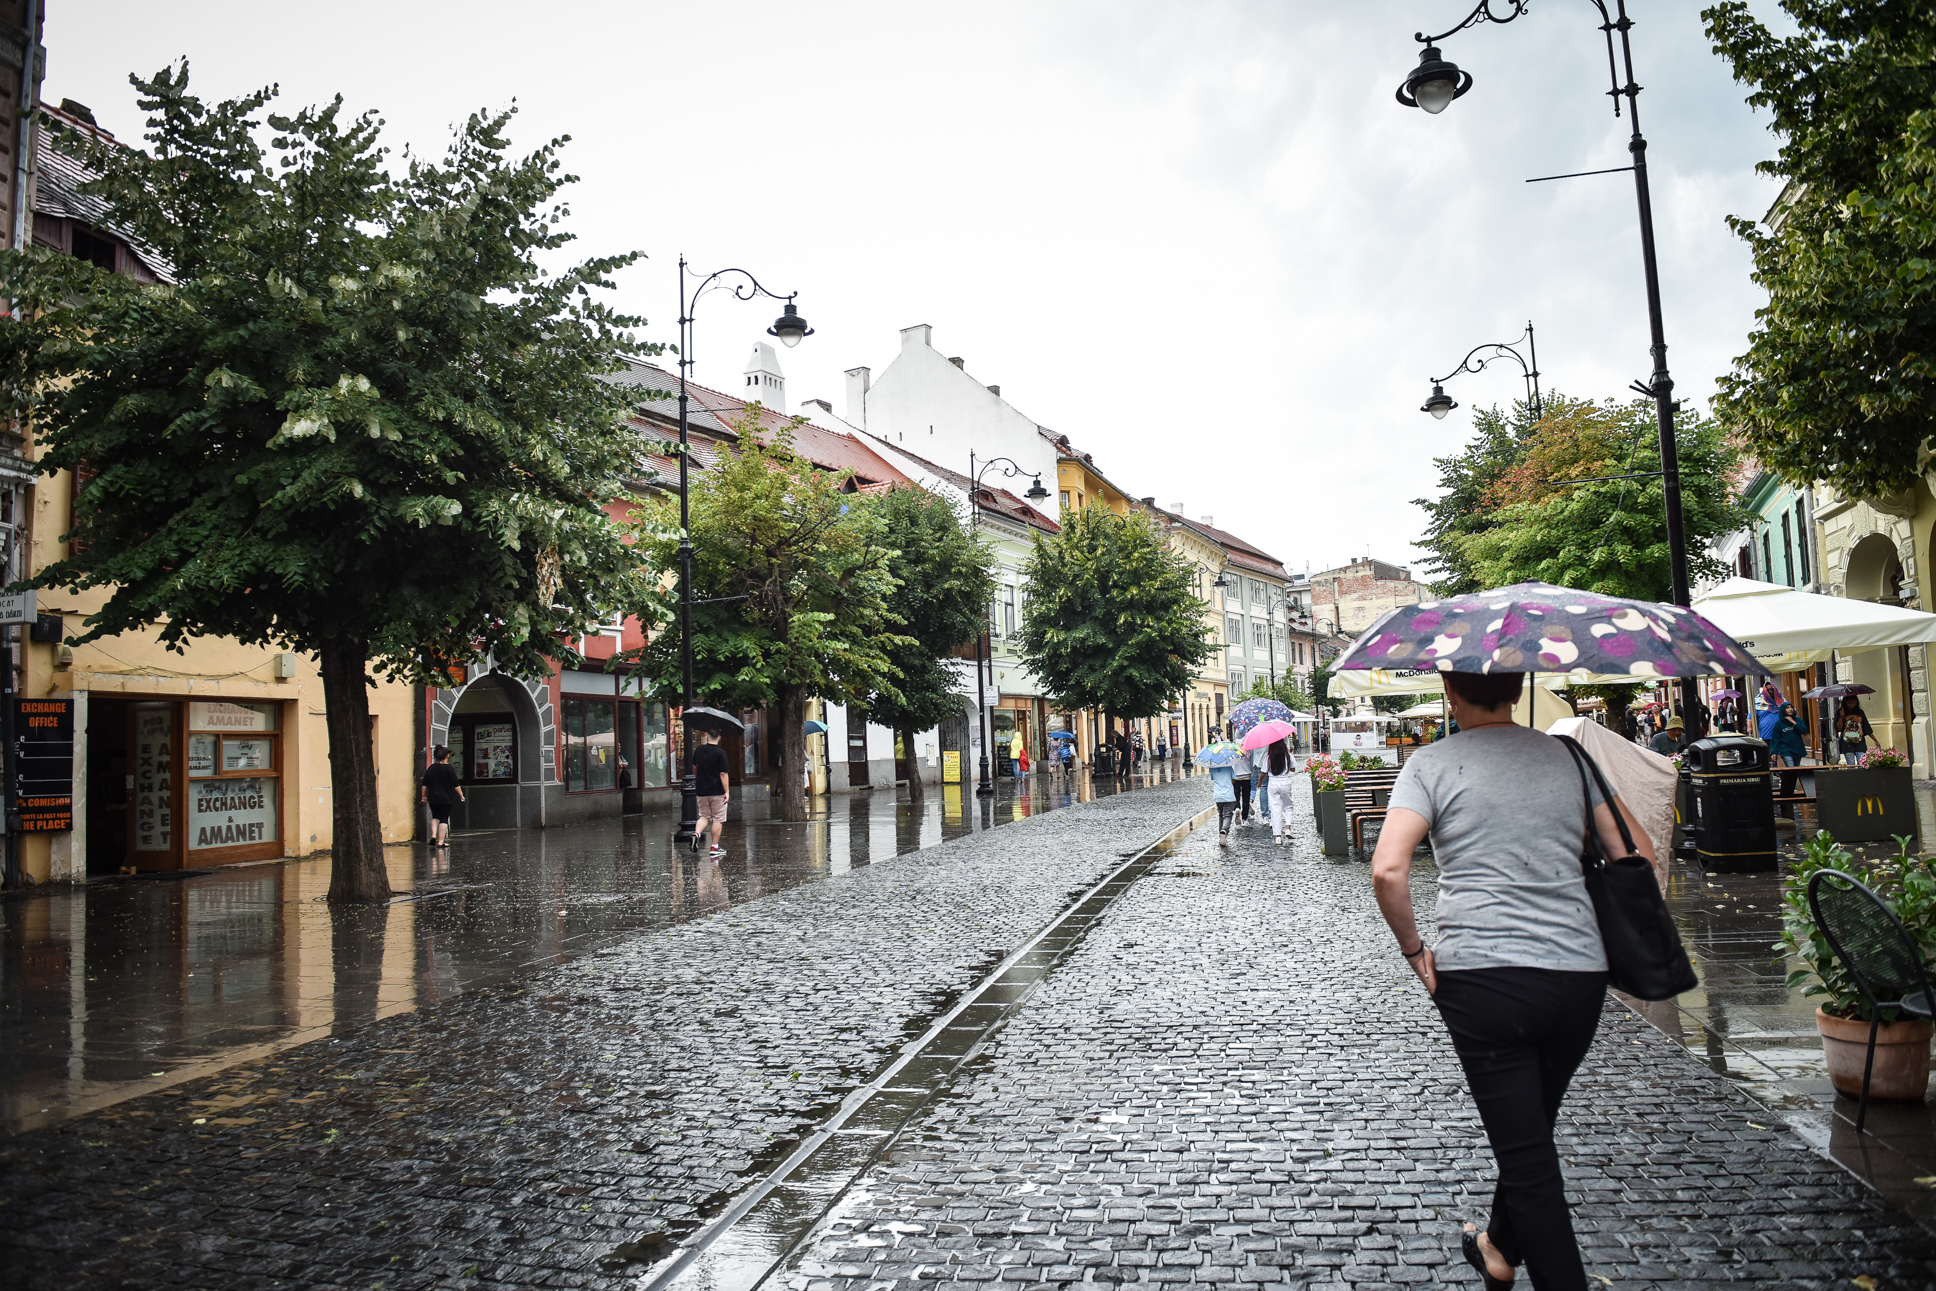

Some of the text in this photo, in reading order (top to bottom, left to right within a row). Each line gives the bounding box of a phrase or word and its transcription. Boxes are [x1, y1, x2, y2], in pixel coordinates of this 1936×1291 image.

[21, 703, 67, 713] EXCHANGE
[207, 704, 255, 714] EXCHANGE
[29, 717, 59, 727] OFFICE
[207, 716, 255, 727] AMANET
[138, 743, 155, 845] EXCHANGE
[156, 743, 171, 845] AMANET
[28, 797, 71, 807] COMISION
[197, 795, 265, 813] EXCHANGE
[227, 815, 234, 823] &
[19, 820, 35, 831] HE
[197, 822, 265, 846] AMANET
